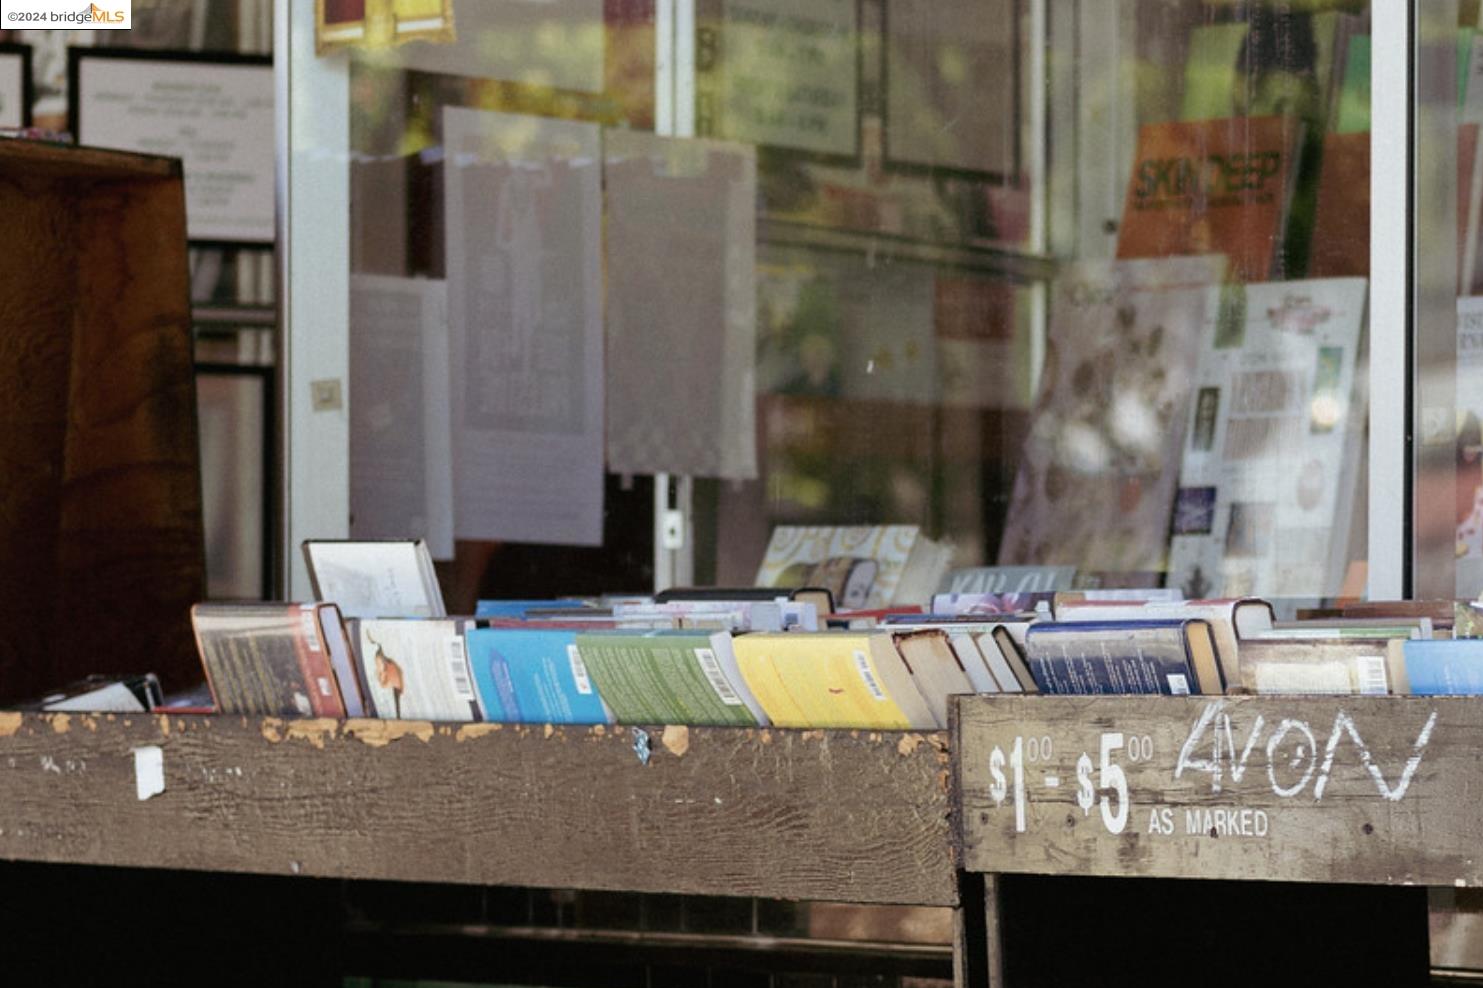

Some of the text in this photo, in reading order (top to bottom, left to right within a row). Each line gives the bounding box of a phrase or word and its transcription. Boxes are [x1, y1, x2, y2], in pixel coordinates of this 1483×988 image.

[1176, 700, 1438, 803] AVON
[1148, 808, 1269, 838] AS MARKED
